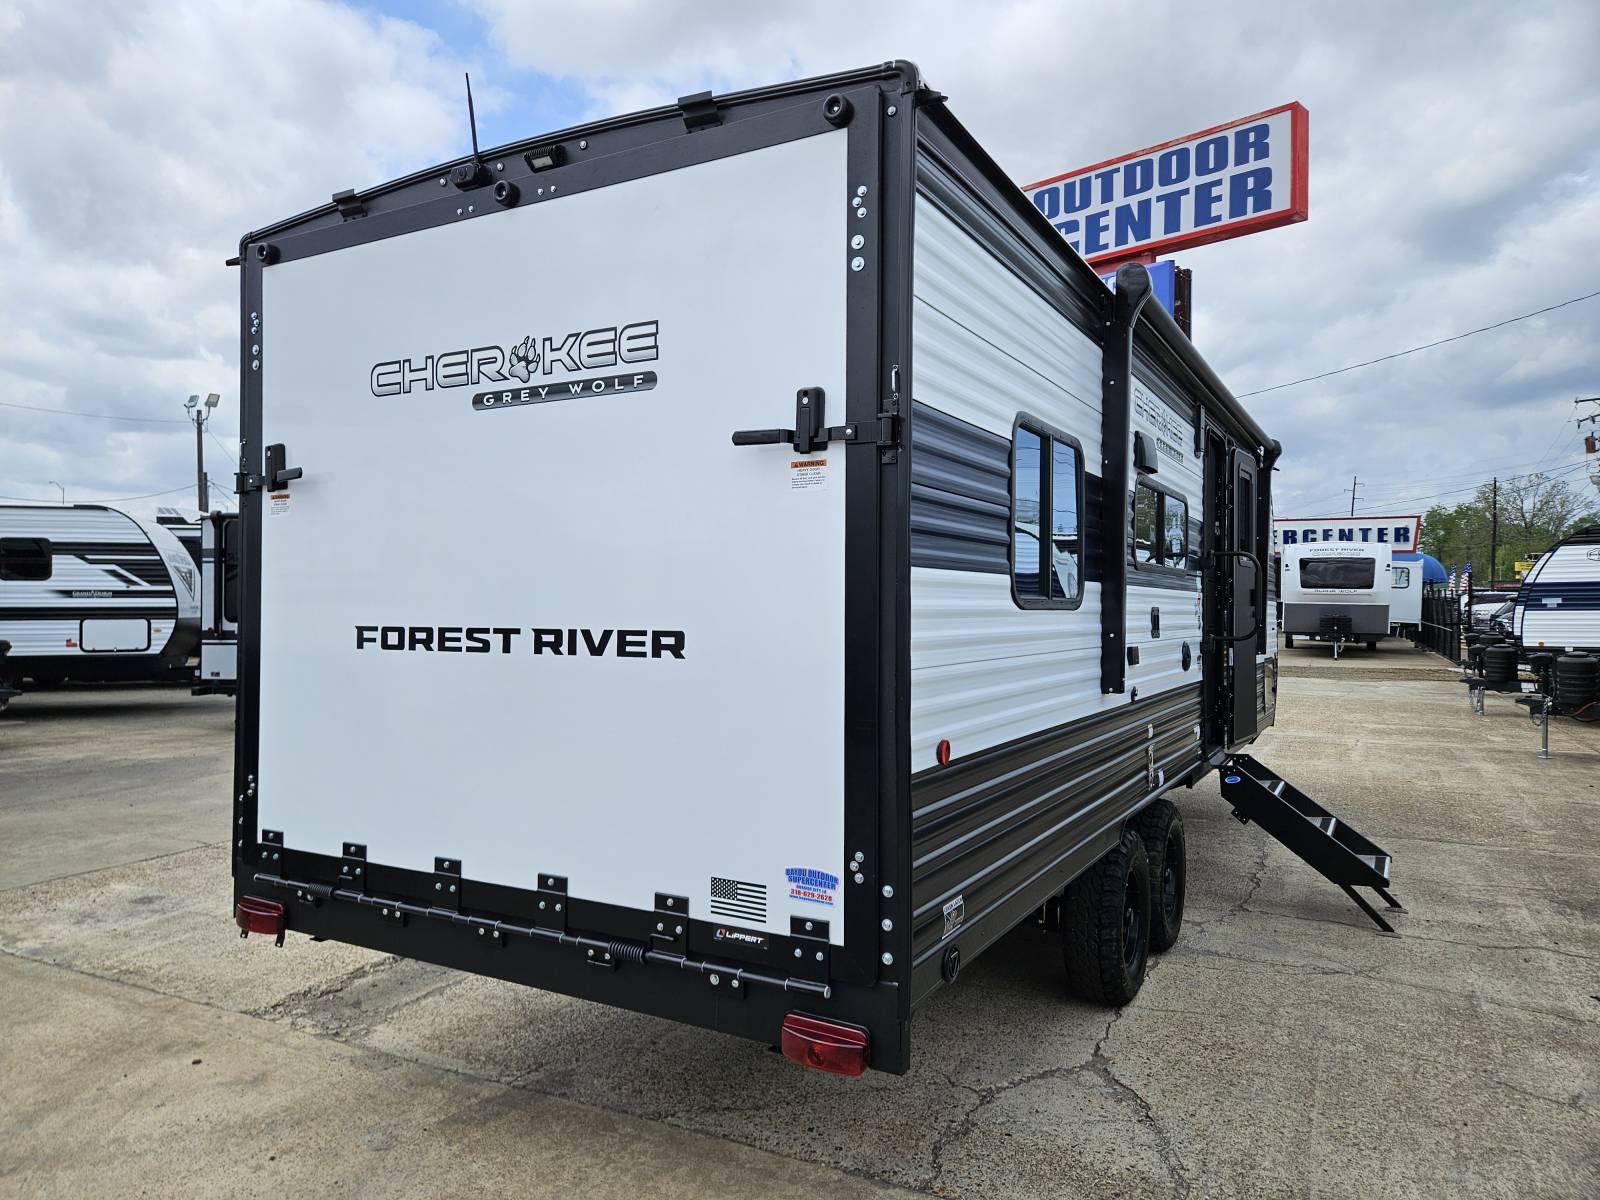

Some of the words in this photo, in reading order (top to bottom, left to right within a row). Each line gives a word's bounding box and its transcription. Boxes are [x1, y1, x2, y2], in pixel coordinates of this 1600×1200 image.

[1034, 123, 1270, 220] OUTDOOR
[483, 386, 550, 407] GREY
[568, 374, 645, 396] WOLF
[354, 625, 522, 655] FOREST
[531, 628, 686, 660] RIVER
[725, 930, 765, 944] LIPPERT
